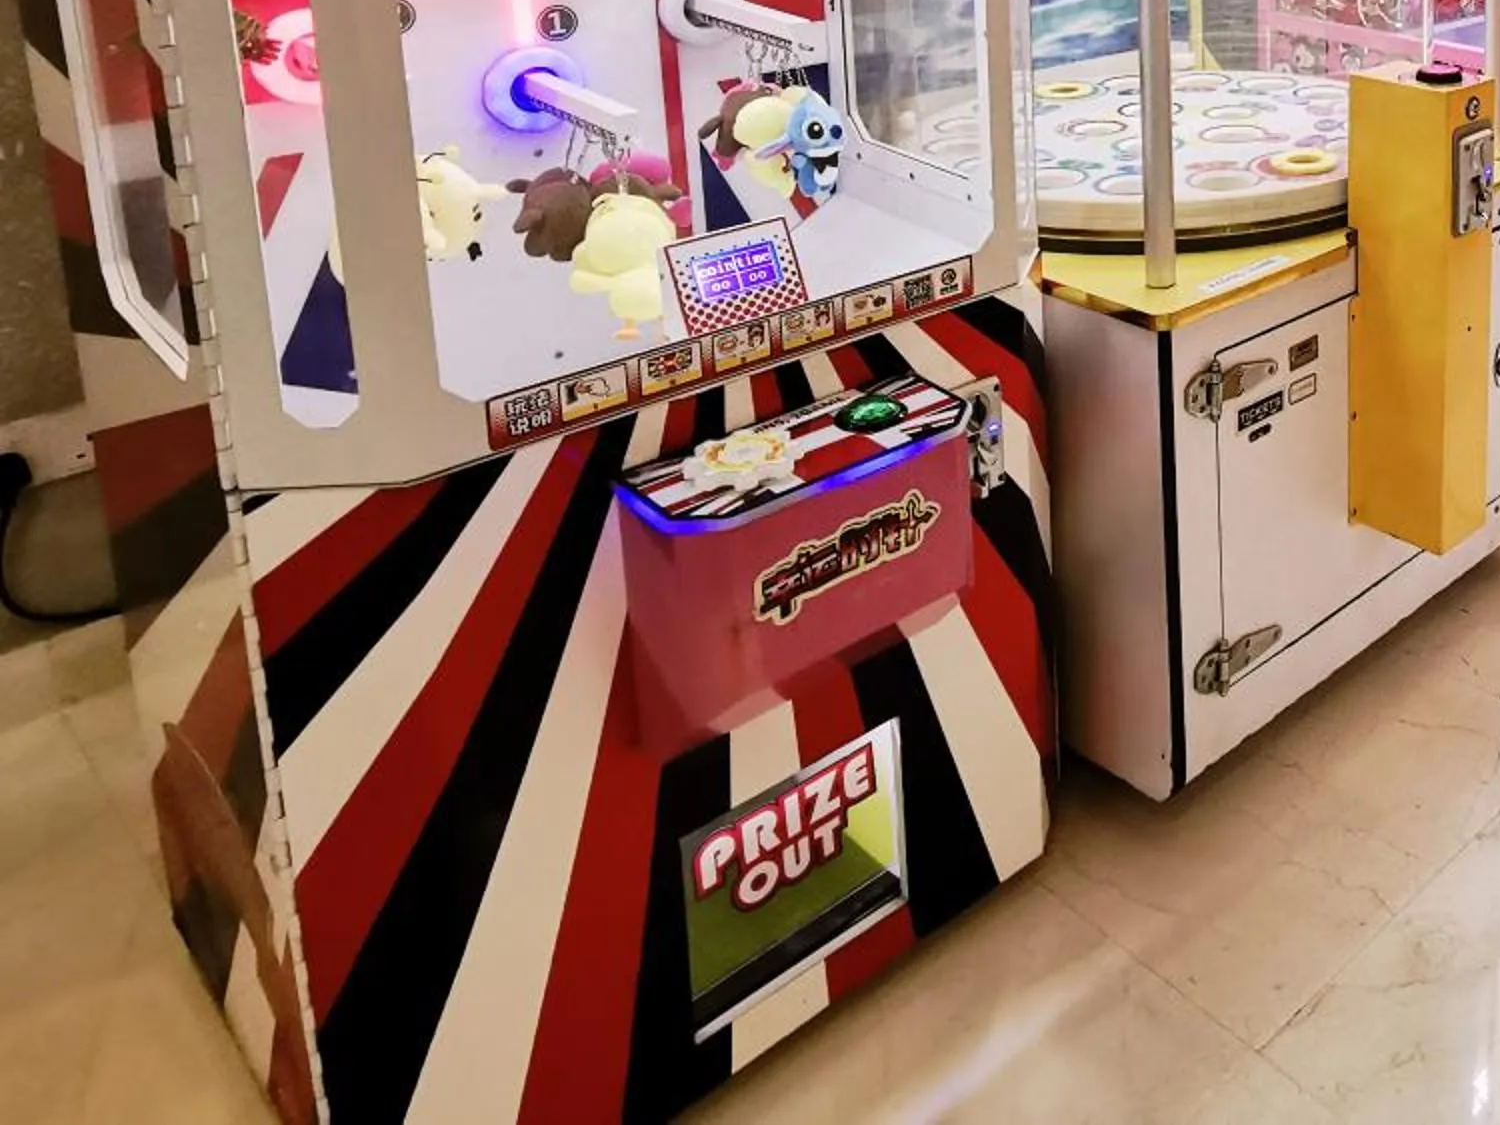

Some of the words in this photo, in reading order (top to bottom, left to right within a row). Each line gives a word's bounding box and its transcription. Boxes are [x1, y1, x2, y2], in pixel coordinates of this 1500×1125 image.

[547, 10, 566, 36] 1
[1240, 395, 1282, 426] TICKETS
[698, 749, 871, 893] PRIZE
[737, 815, 842, 905] OUT
